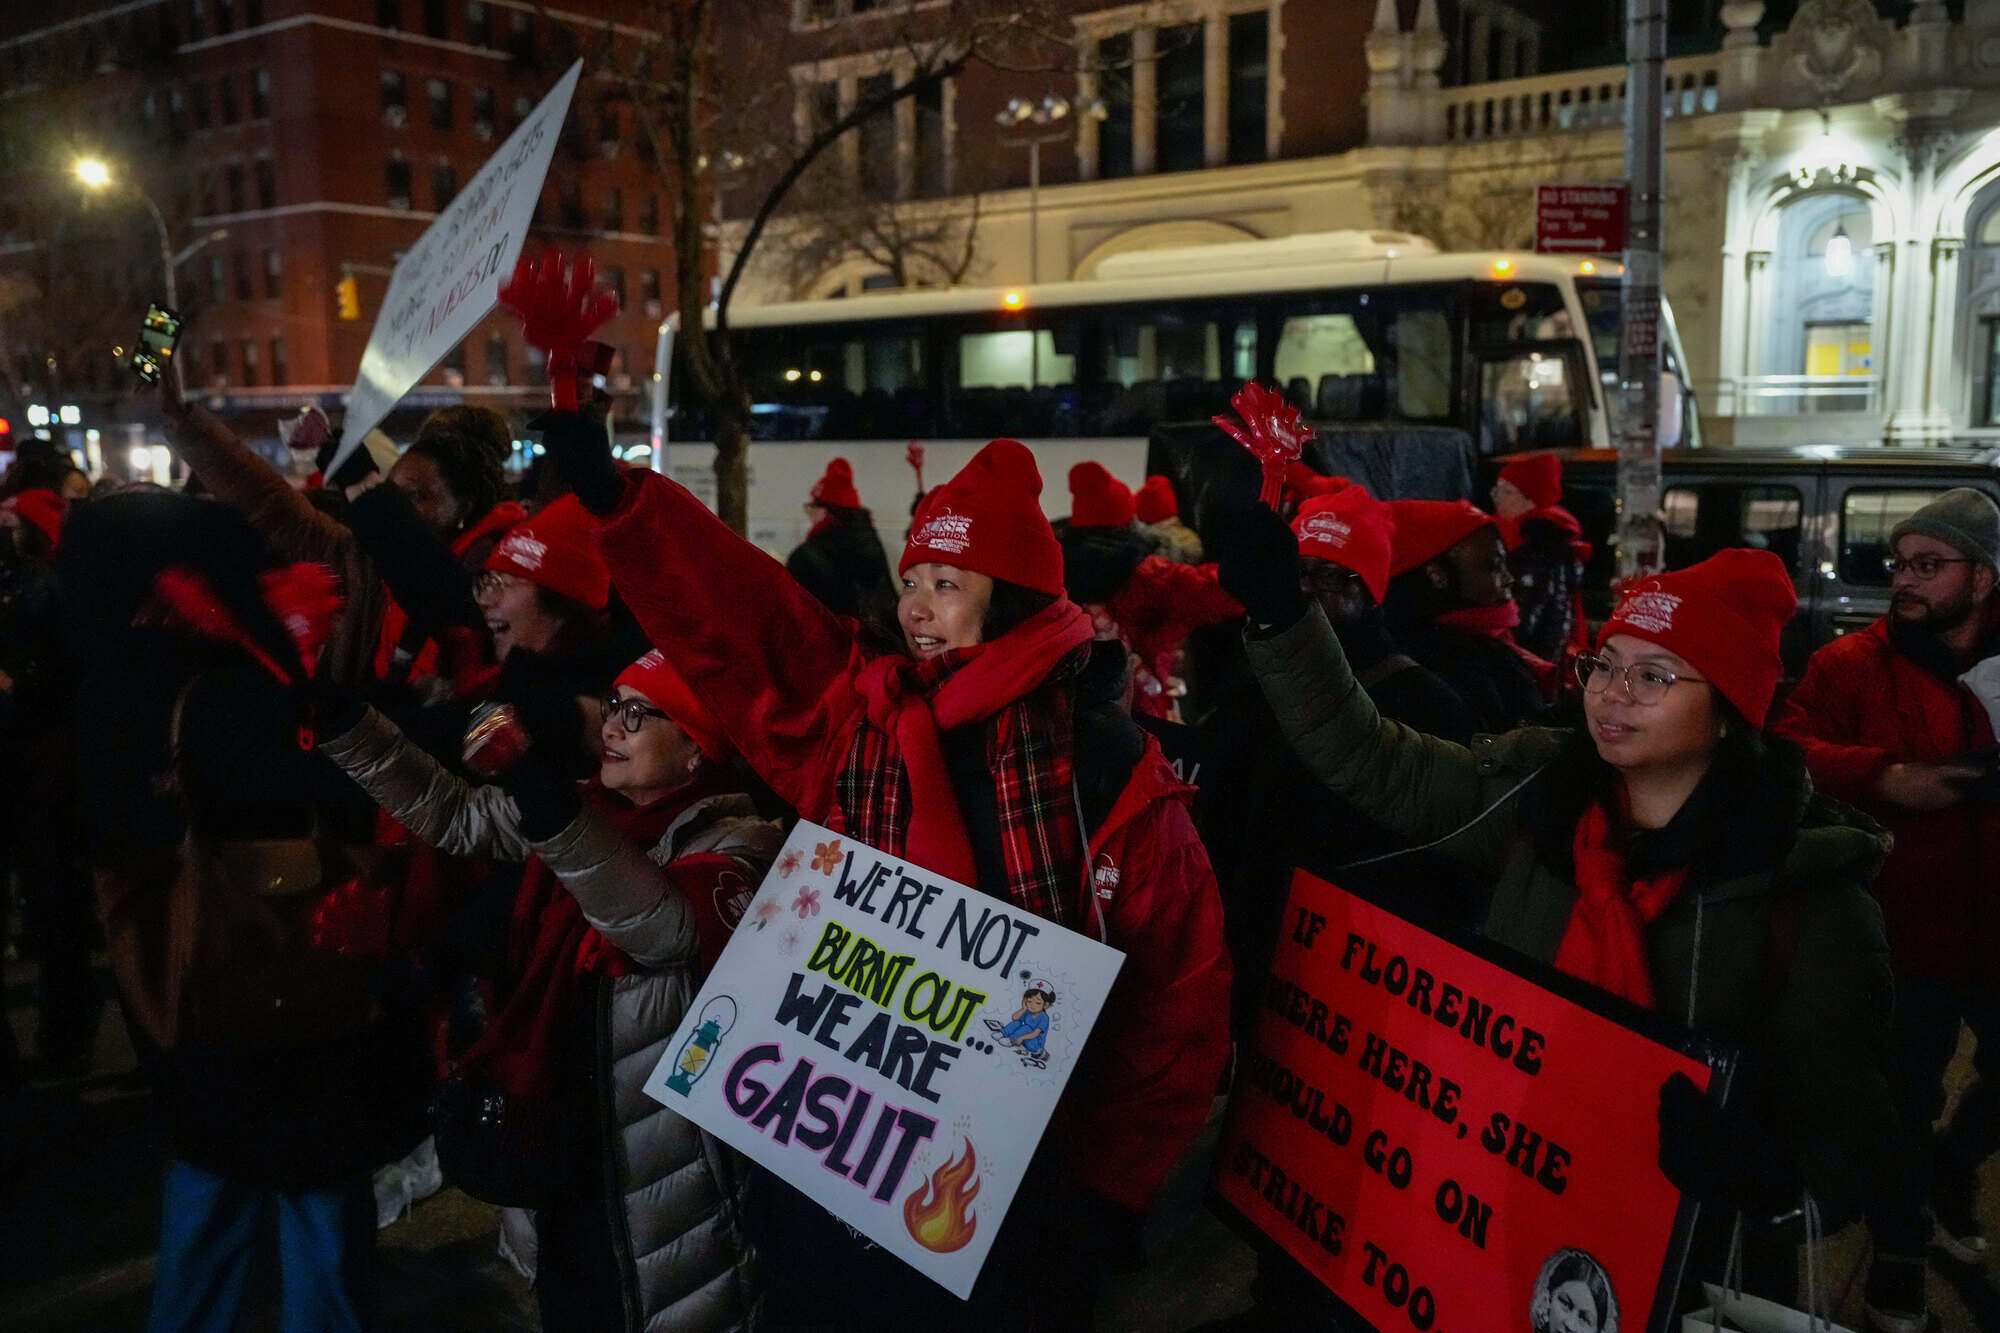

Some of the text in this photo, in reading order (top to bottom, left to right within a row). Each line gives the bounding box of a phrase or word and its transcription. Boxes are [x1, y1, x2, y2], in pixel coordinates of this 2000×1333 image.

[806, 921, 915, 1009] BURNT
[833, 850, 1040, 980] WE'RE NOT
[774, 971, 963, 1104] WE ARE
[1293, 906, 1546, 1076] IF FLORENCE
[723, 1043, 940, 1206] GASLIT
[1250, 1053, 1494, 1250] WOULD GO ON
[1266, 973, 1572, 1196] WERE HERE, SHE
[1232, 1146, 1346, 1257] STRIKE
